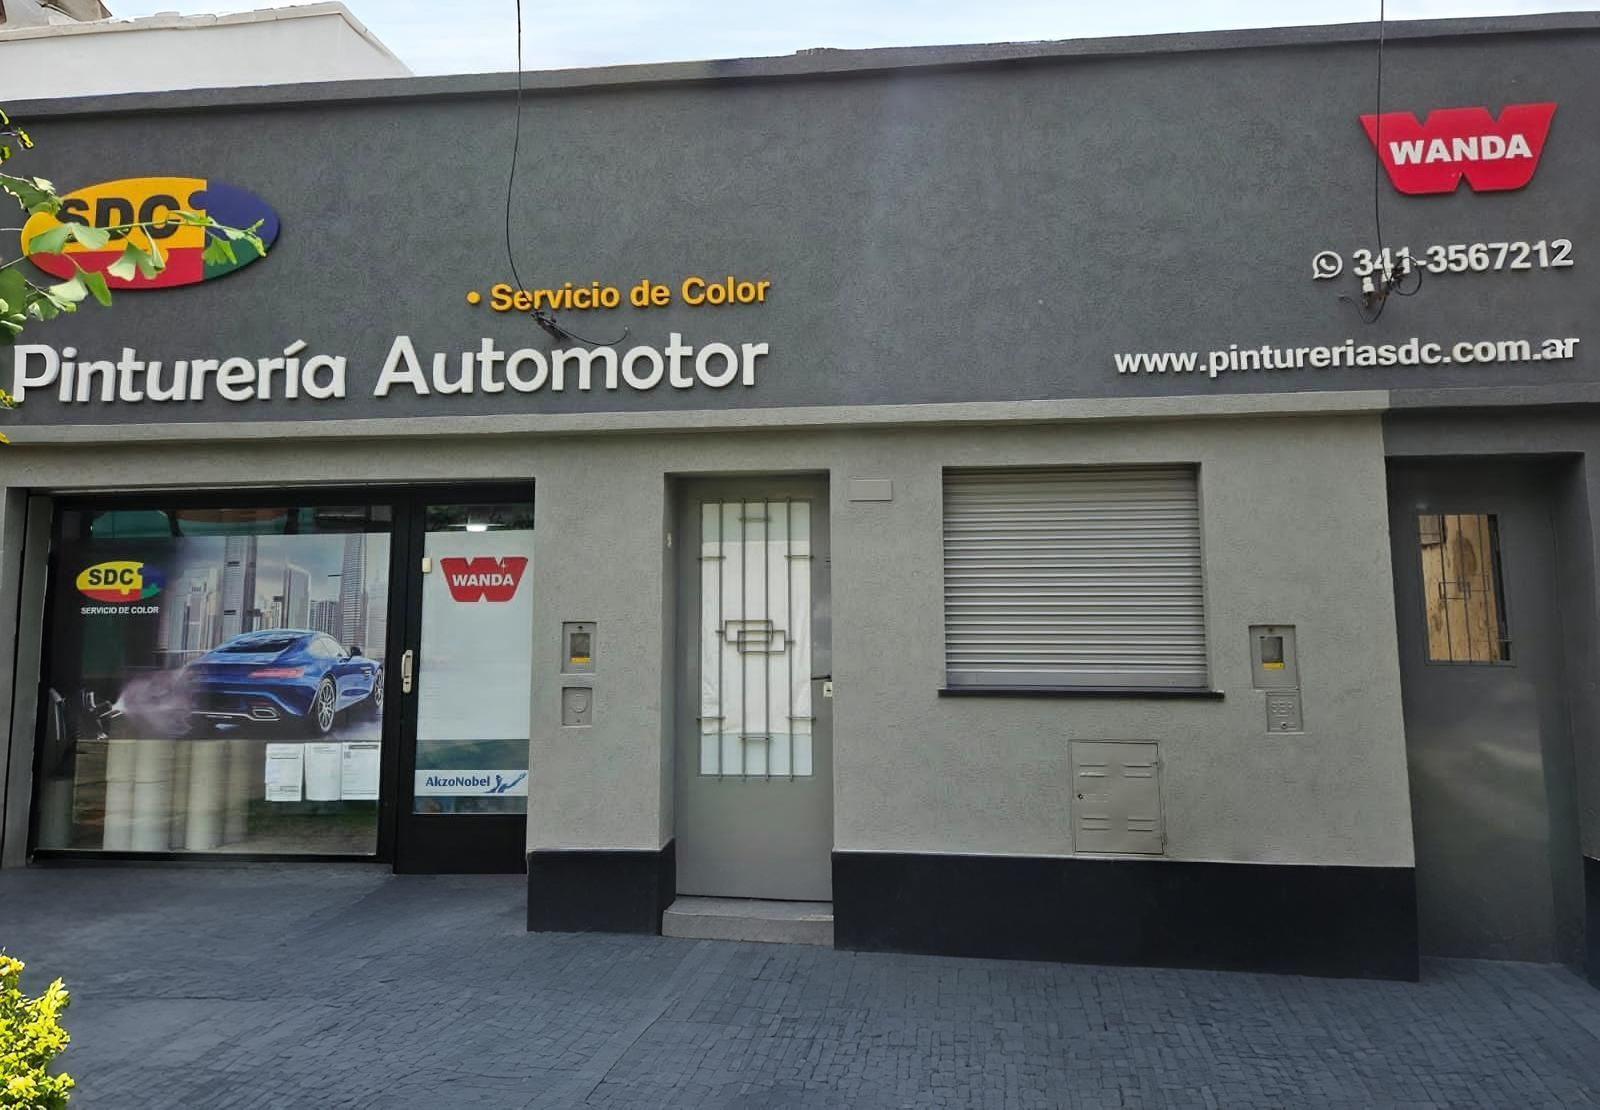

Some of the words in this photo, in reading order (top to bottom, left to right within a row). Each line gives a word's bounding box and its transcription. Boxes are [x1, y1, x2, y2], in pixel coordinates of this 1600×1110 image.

[1390, 134, 1532, 165] WANDA
[56, 194, 181, 243] SDC
[1352, 238, 1574, 276] 341-3567212
[490, 282, 620, 312] Servicio
[629, 280, 671, 307] de
[681, 276, 770, 305] Color
[12, 339, 347, 402] Pinturería
[373, 332, 769, 397] Automotor
[1114, 336, 1580, 378] www.pintureriasdc.com.ar
[88, 568, 134, 585] SDC
[452, 573, 515, 587] WANDA
[81, 606, 117, 615] SERVICIO
[118, 606, 130, 614] DE
[131, 606, 159, 614] COLOR
[425, 775, 490, 787] AkzoNobel
